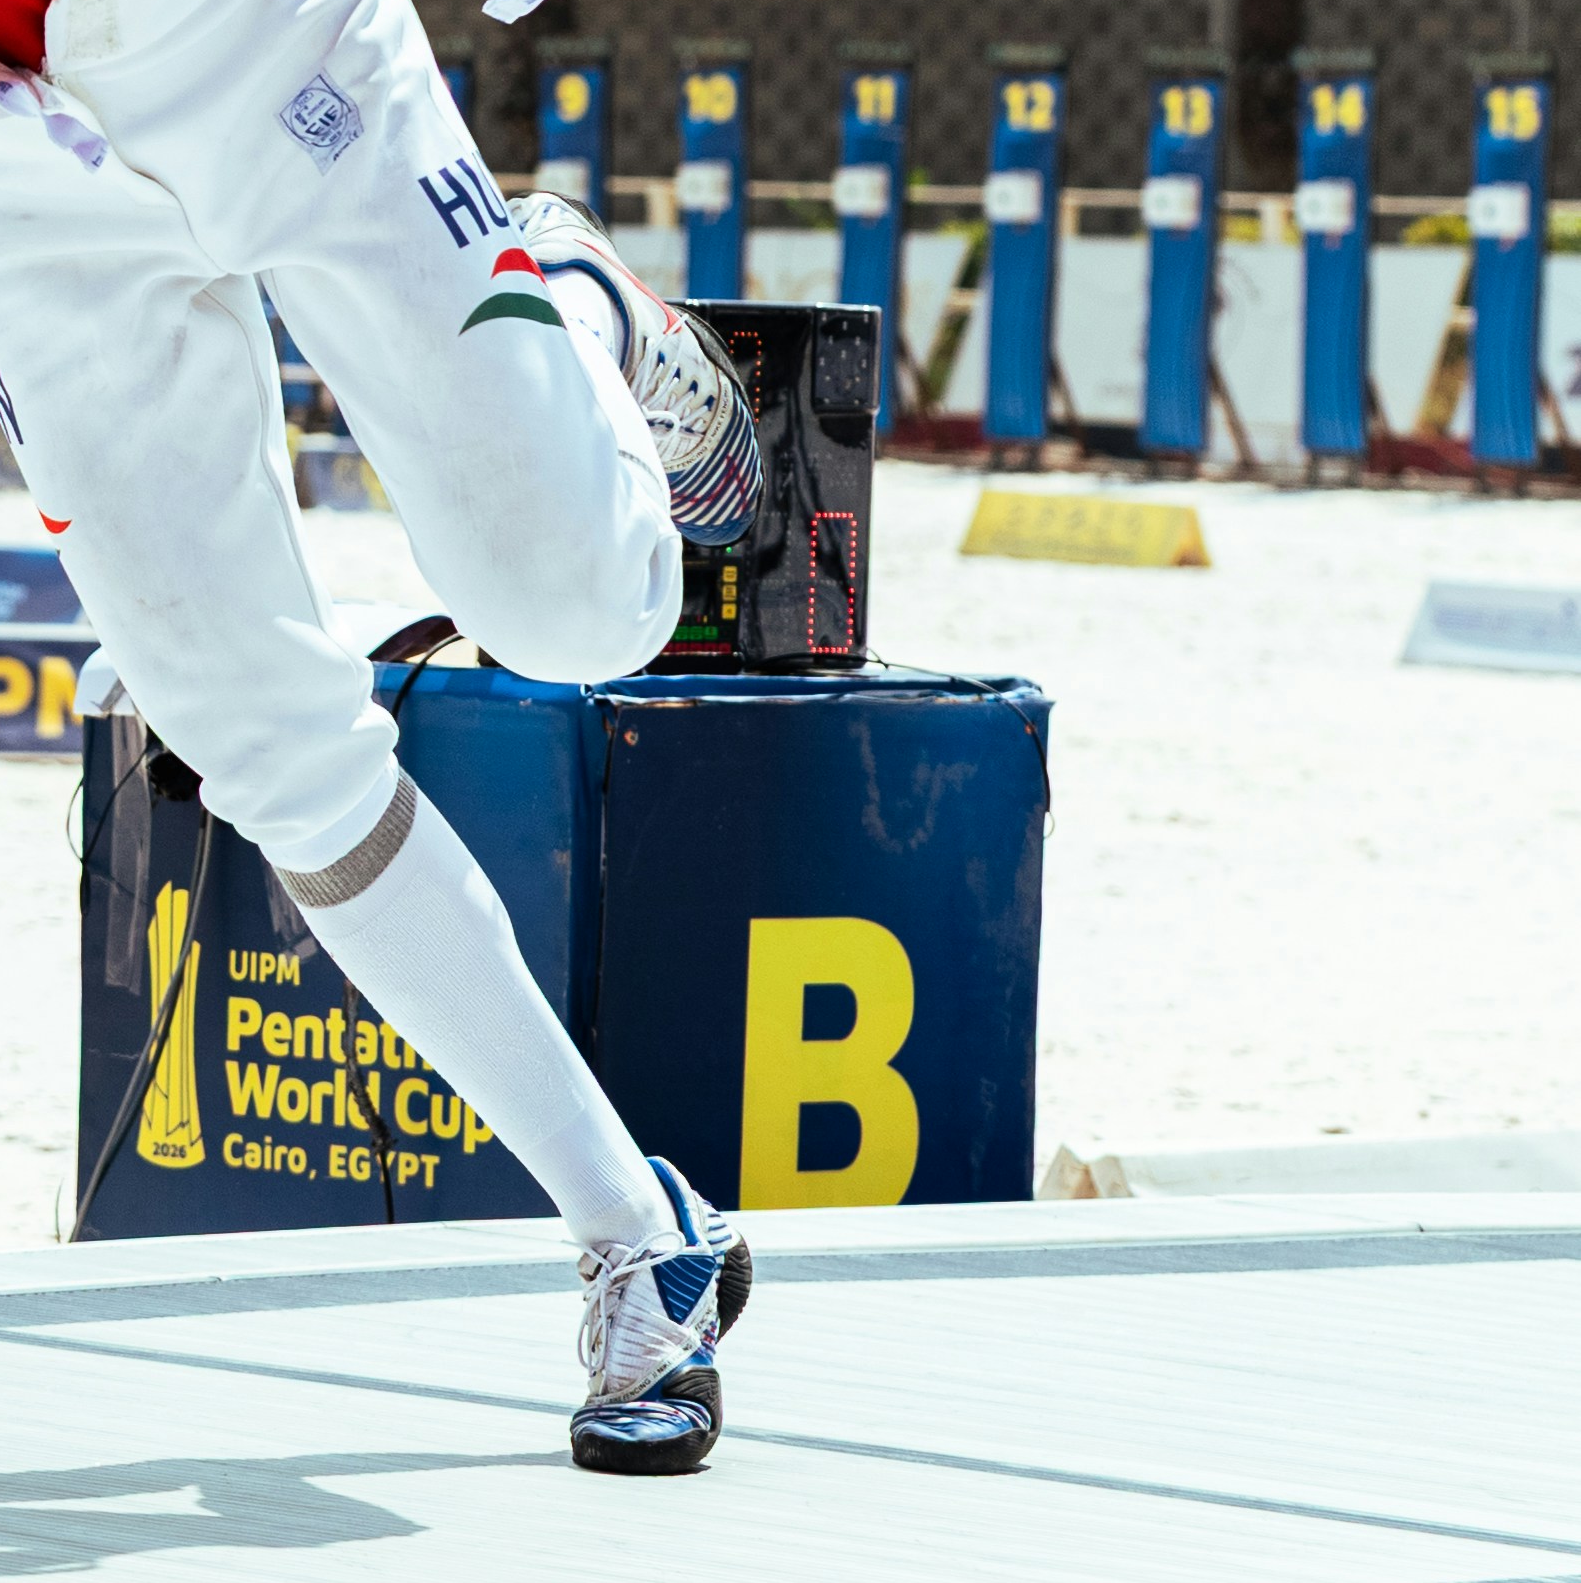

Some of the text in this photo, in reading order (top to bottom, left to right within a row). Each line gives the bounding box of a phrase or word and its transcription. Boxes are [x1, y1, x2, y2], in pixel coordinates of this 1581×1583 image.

[555, 72, 590, 121] 9
[684, 73, 736, 122] 10
[853, 74, 897, 122] 11
[1002, 80, 1054, 132] 12
[1161, 85, 1213, 137] 13
[1311, 85, 1366, 133] 14
[1484, 88, 1542, 140] 15
[228, 949, 301, 987] UIPM
[739, 917, 920, 1211] B
[225, 1060, 495, 1154] World Cup
[152, 1142, 187, 1159] 2026
[223, 1132, 316, 1180] Cairo,
